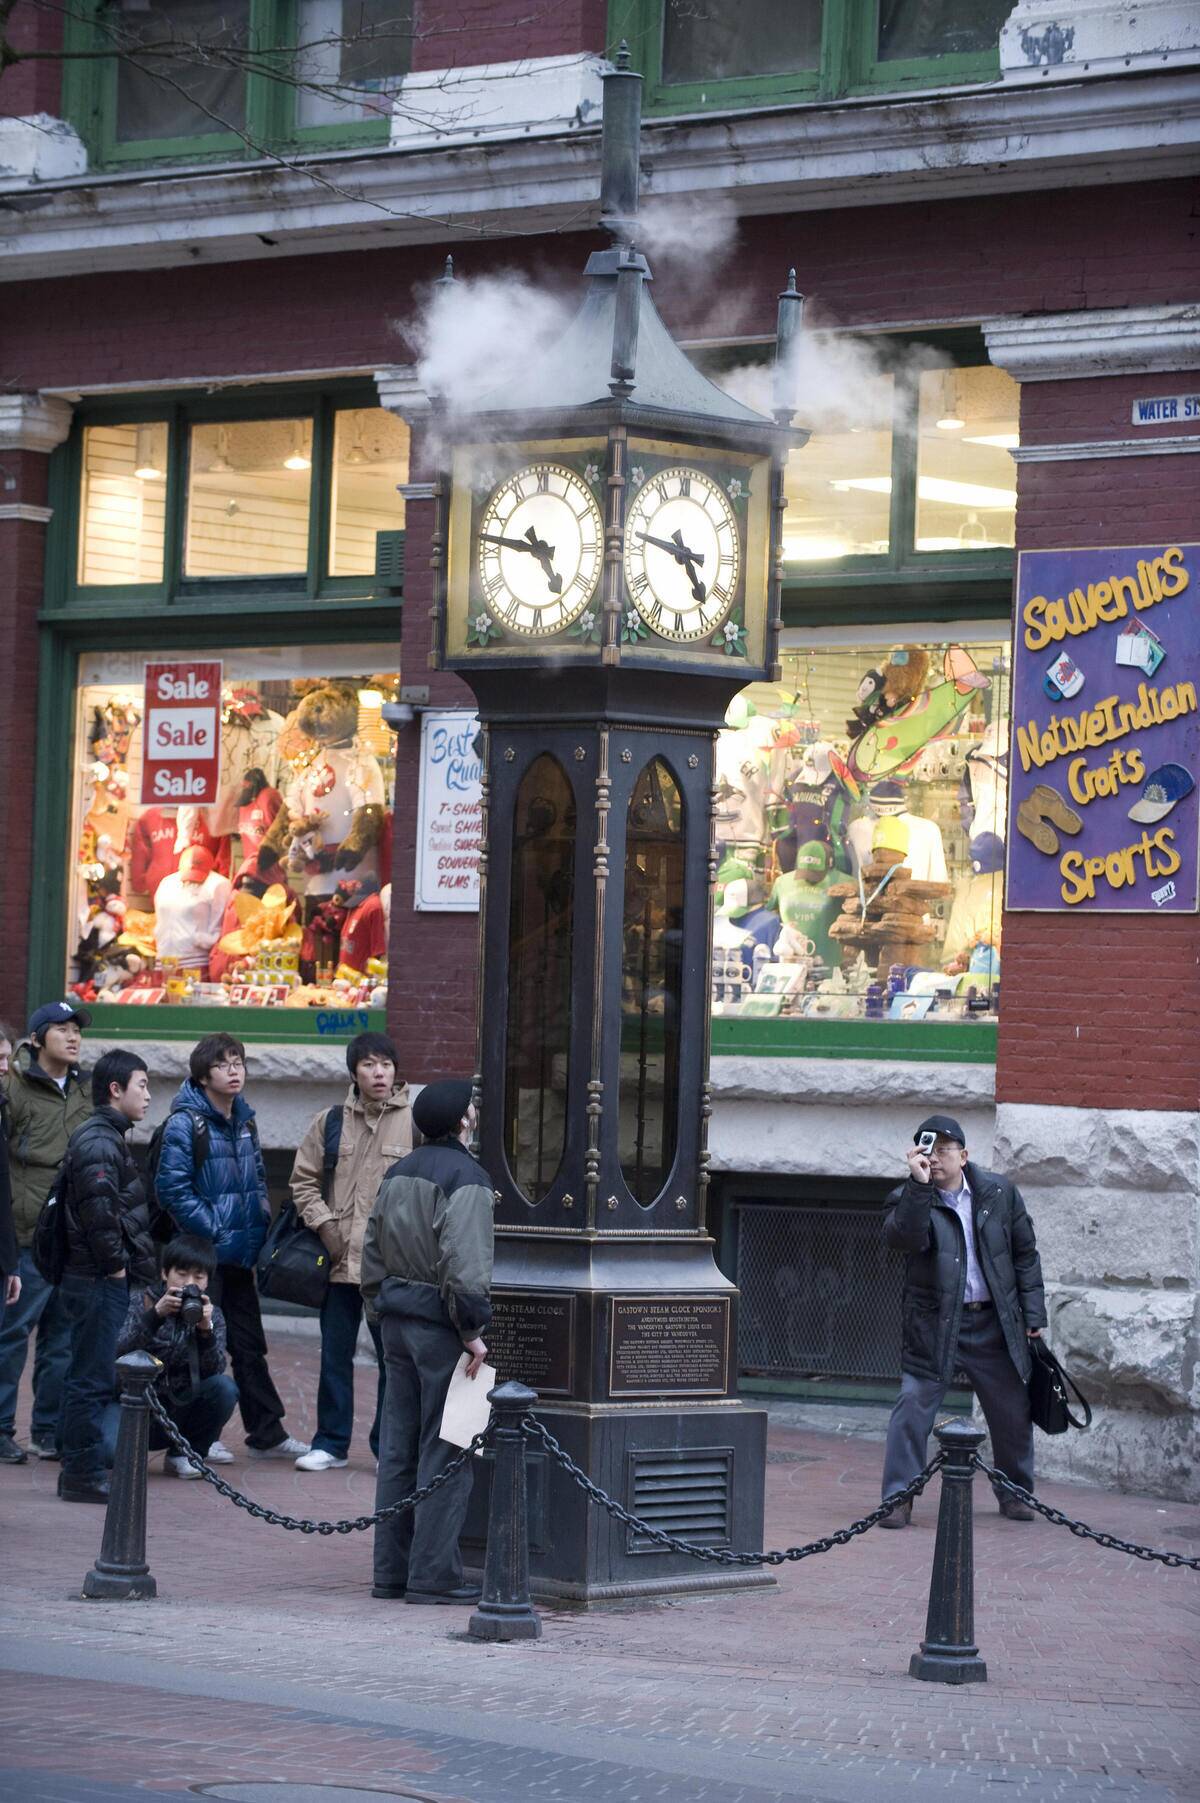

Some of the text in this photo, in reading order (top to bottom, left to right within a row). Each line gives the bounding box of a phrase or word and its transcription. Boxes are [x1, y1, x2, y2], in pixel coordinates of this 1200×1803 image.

[1138, 399, 1178, 420] WATER
[157, 672, 209, 700] Sale
[156, 720, 207, 747] Sale
[1017, 681, 1197, 773] Native Indian
[431, 723, 474, 763] Best
[153, 768, 207, 796] Sale
[1068, 748, 1146, 805] Crafts
[439, 802, 482, 816] T-SHIR
[1060, 827, 1181, 904] Sports
[438, 875, 470, 889] FILMS
[510, 1305, 536, 1314] STEAM
[537, 1306, 564, 1315] CLOCK
[617, 1306, 648, 1314] GASTOWN
[649, 1306, 670, 1314] STEAM
[671, 1305, 691, 1314] CLOCK
